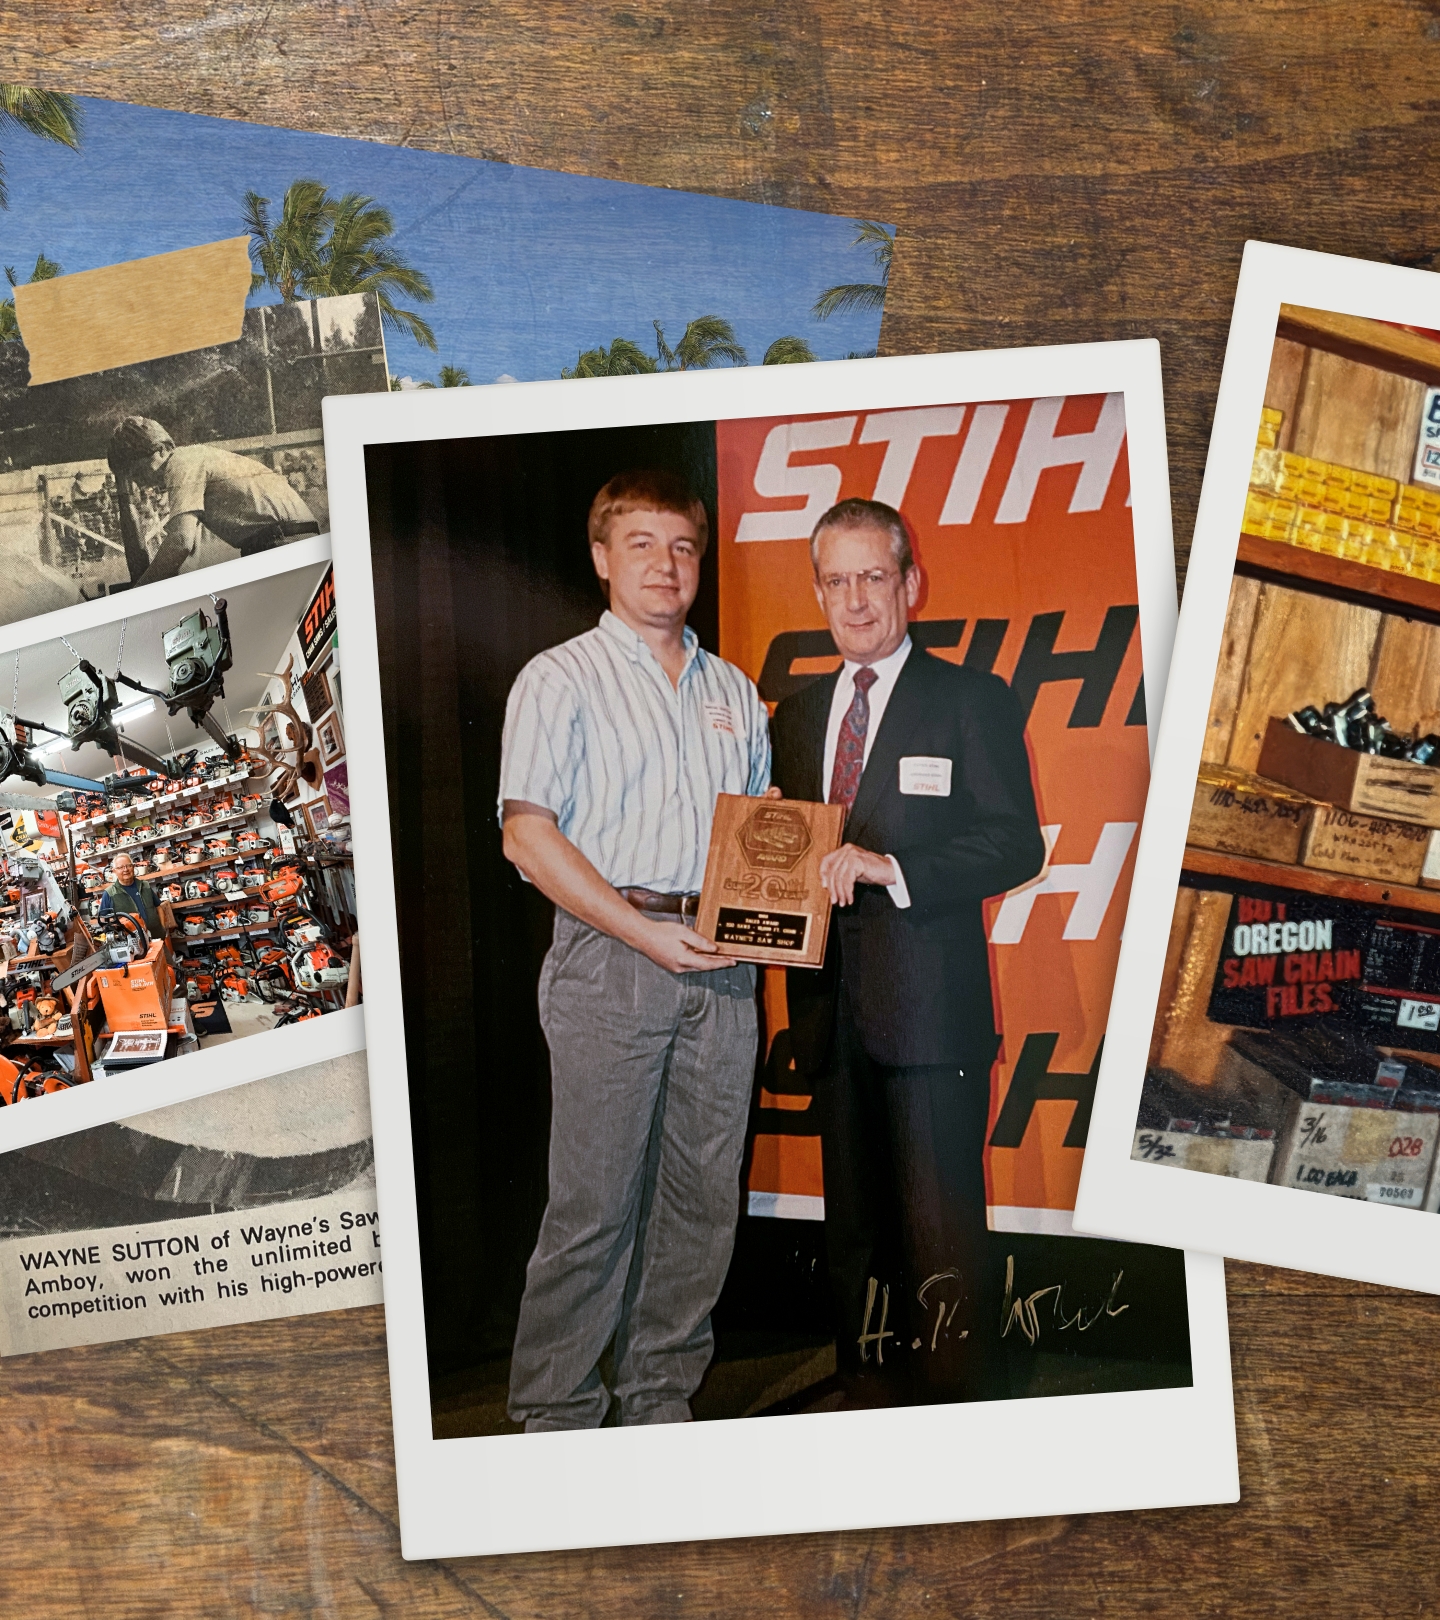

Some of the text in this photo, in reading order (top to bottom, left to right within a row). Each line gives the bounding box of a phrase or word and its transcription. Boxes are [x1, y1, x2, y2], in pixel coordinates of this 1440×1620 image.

[735, 391, 1132, 544] STIH
[913, 783, 939, 792] STIHL
[723, 933, 754, 942] WAYNE'S
[757, 936, 773, 944] SAW
[1233, 919, 1333, 957] OREGON
[16, 958, 46, 970] STIHL
[71, 965, 86, 978] STIHL
[1223, 956, 1278, 989] SAW
[1283, 949, 1361, 985] CHAIN
[1267, 983, 1339, 1018] FILES.
[1138, 1134, 1177, 1161] 5/32
[1300, 1112, 1328, 1148] 3/16
[20, 1246, 101, 1271] WAYNE
[112, 1235, 200, 1263] SUTTON
[211, 1229, 231, 1250] of
[240, 1216, 331, 1246] Wayne's
[24, 1274, 105, 1297] Amboy,
[126, 1265, 171, 1284] won
[193, 1255, 229, 1276] the
[250, 1234, 353, 1267] unlimited
[28, 1294, 147, 1319] competition
[158, 1286, 205, 1307] with
[217, 1280, 249, 1299] his
